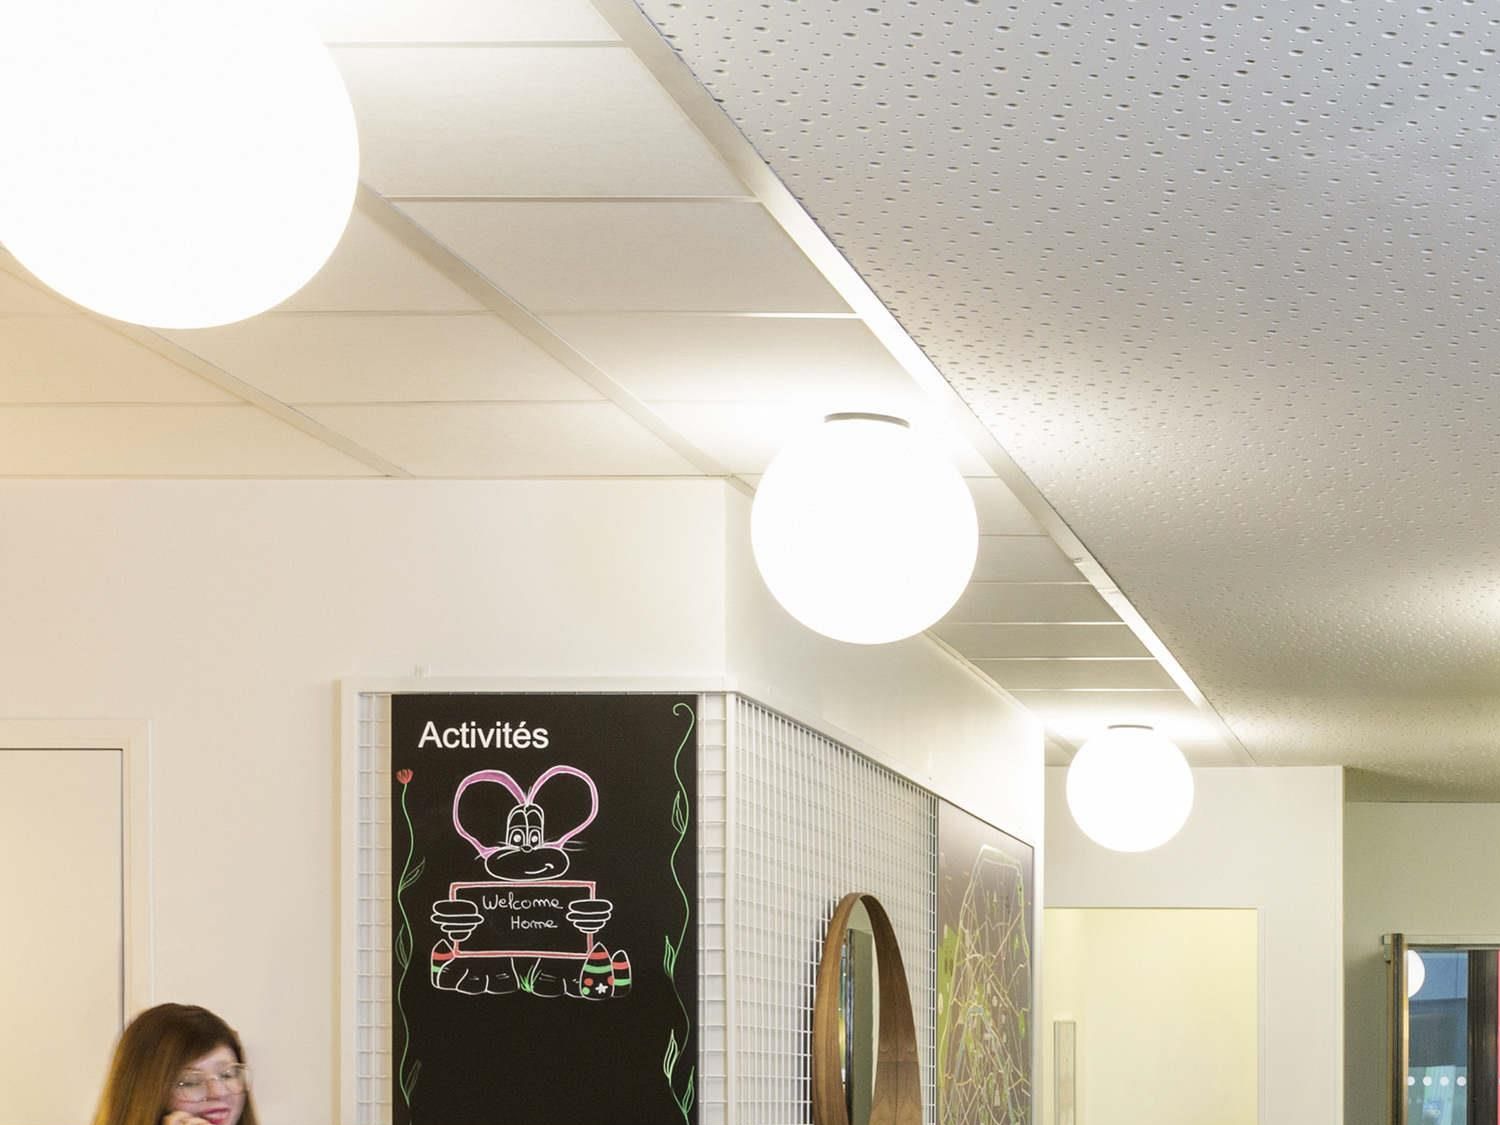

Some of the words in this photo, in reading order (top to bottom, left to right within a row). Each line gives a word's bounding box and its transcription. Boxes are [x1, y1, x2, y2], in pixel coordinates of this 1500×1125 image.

[418, 721, 550, 749] Activités
[482, 892, 563, 910] Welcome
[511, 916, 558, 930] Home
